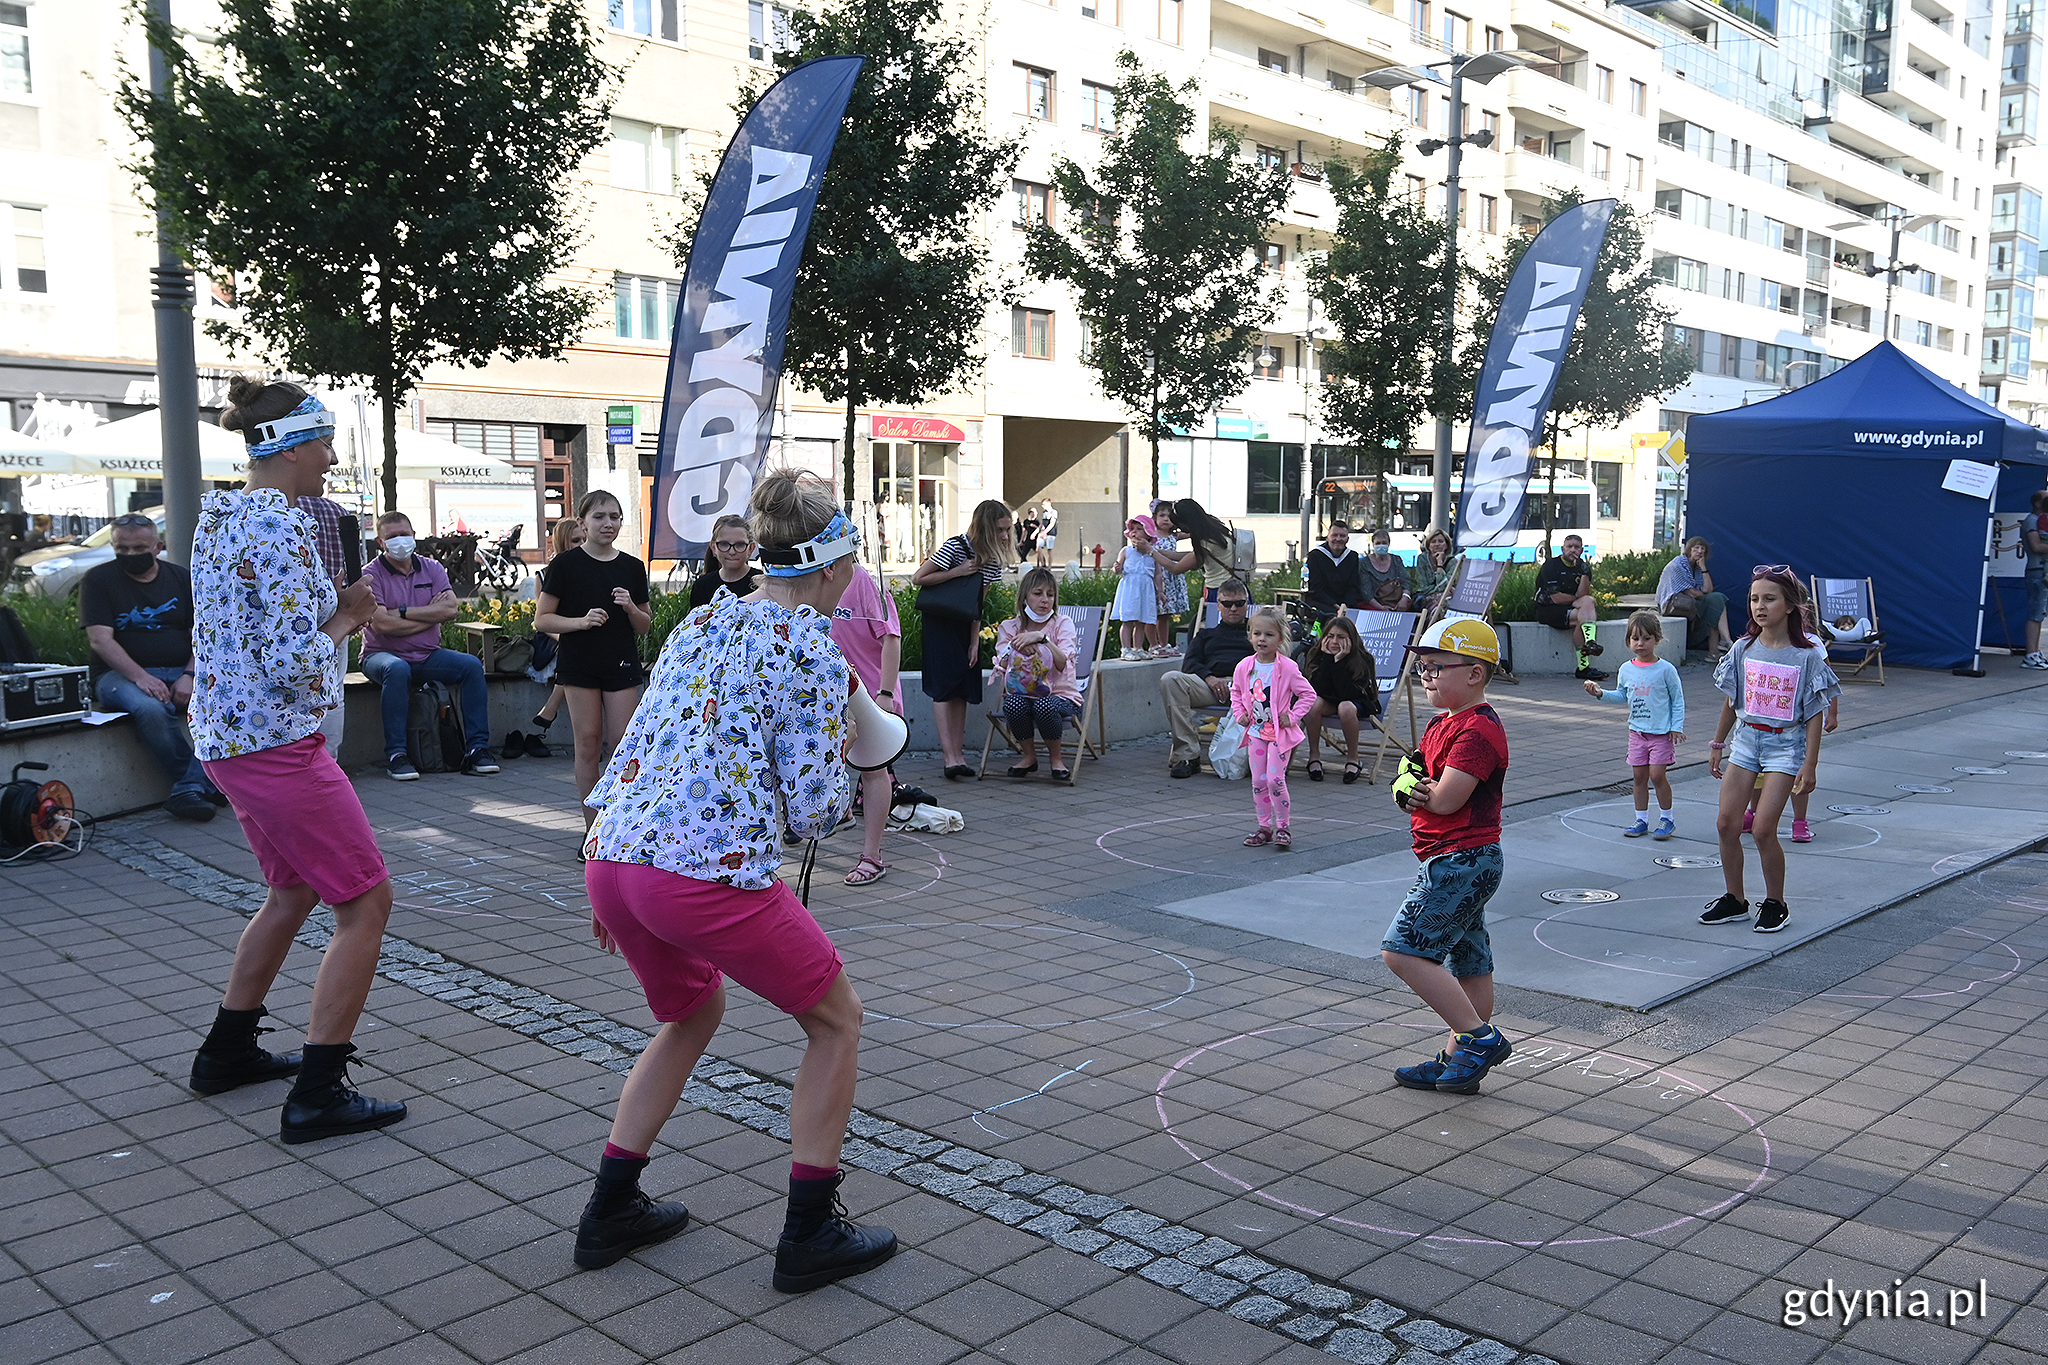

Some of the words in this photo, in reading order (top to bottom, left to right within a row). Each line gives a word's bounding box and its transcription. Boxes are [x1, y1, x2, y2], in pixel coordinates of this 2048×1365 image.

[668, 145, 812, 544] GDYNIA
[1464, 261, 1582, 536] GDYNIA
[878, 418, 909, 437] Salon
[911, 420, 950, 438] Damski
[1854, 430, 1984, 449] www.gdynia.pl
[0, 455, 44, 467] ĄŻĘCE
[441, 466, 491, 478] KSIĄŻĘCE
[1325, 482, 1336, 492] 22
[1460, 595, 1486, 604] FILMOWE
[1462, 588, 1489, 597] CENTRUM
[1363, 638, 1394, 648] YŃSKIE
[1746, 672, 1793, 691] GIRL
[1746, 689, 1791, 709] PWR
